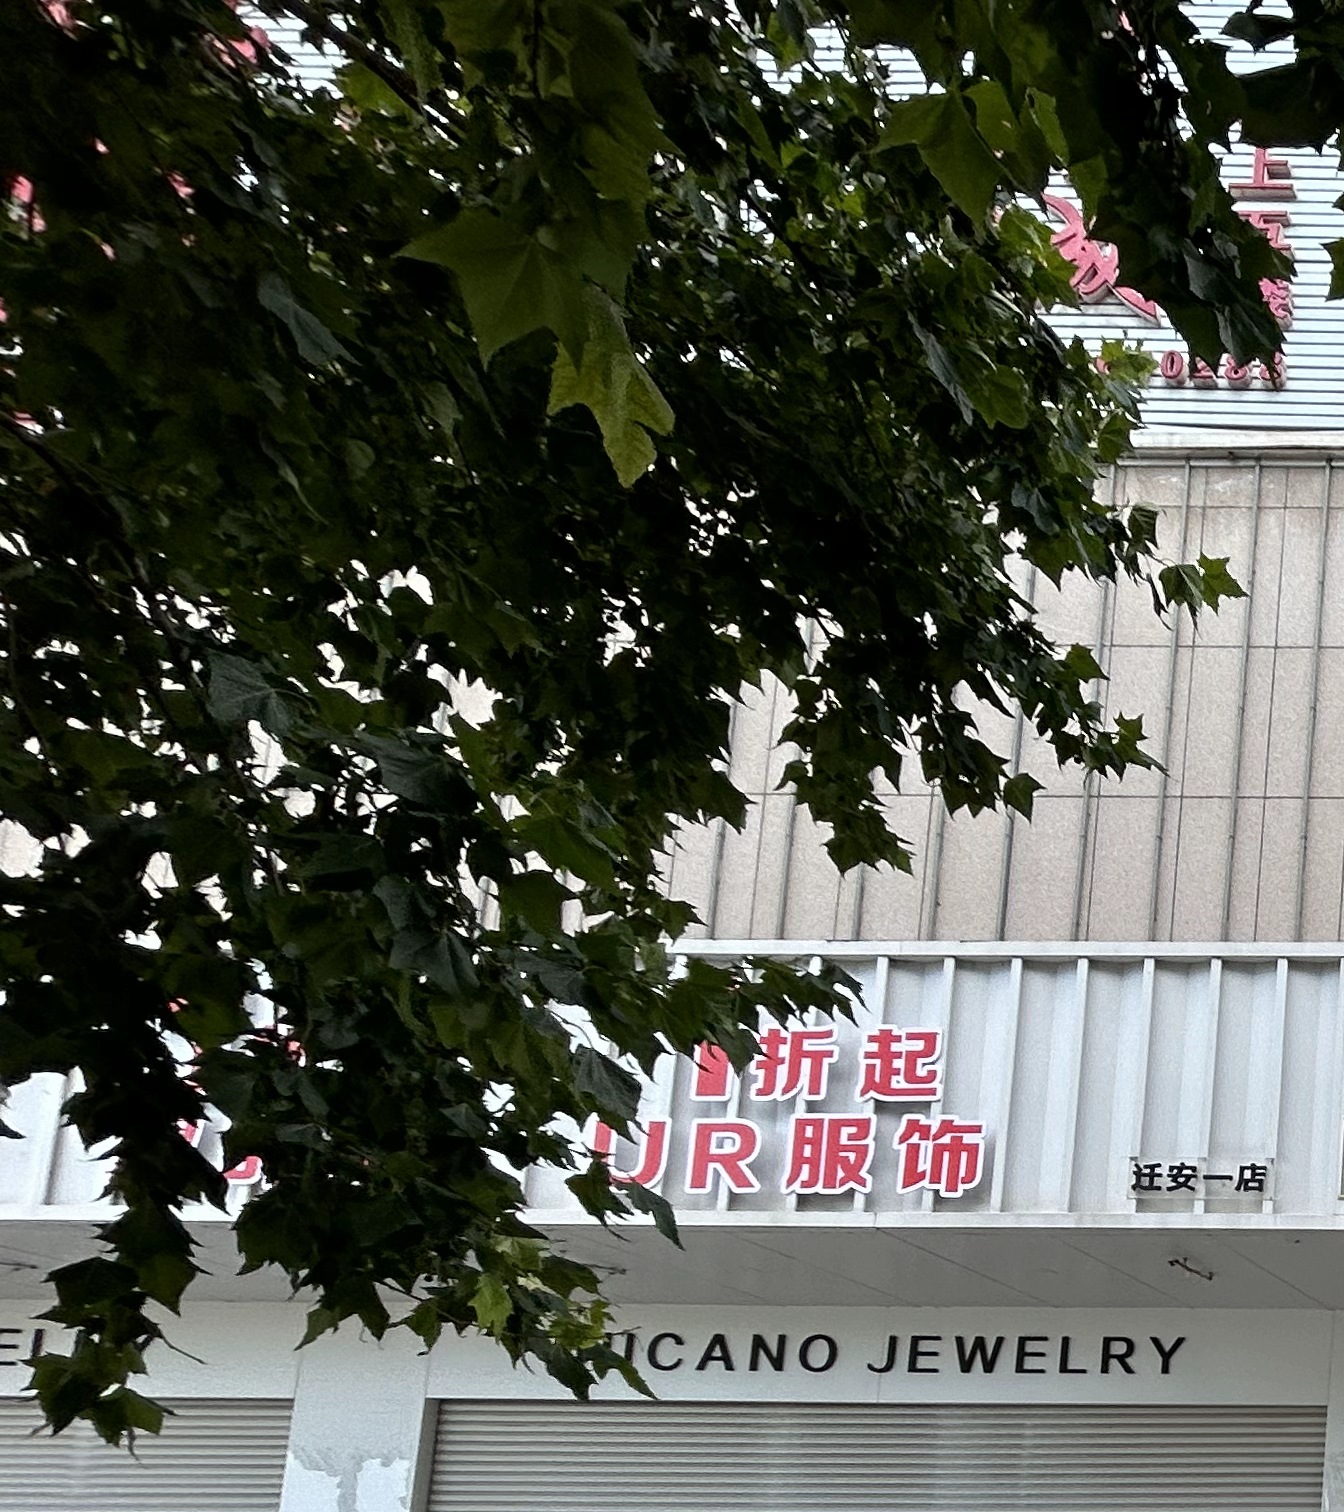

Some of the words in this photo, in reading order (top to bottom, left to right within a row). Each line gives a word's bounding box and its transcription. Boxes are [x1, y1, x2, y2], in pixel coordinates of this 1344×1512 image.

[1131, 1161, 1268, 1193] 迁安一店
[603, 1331, 840, 1374] ICANO
[866, 1334, 1188, 1376] JEWELRY
